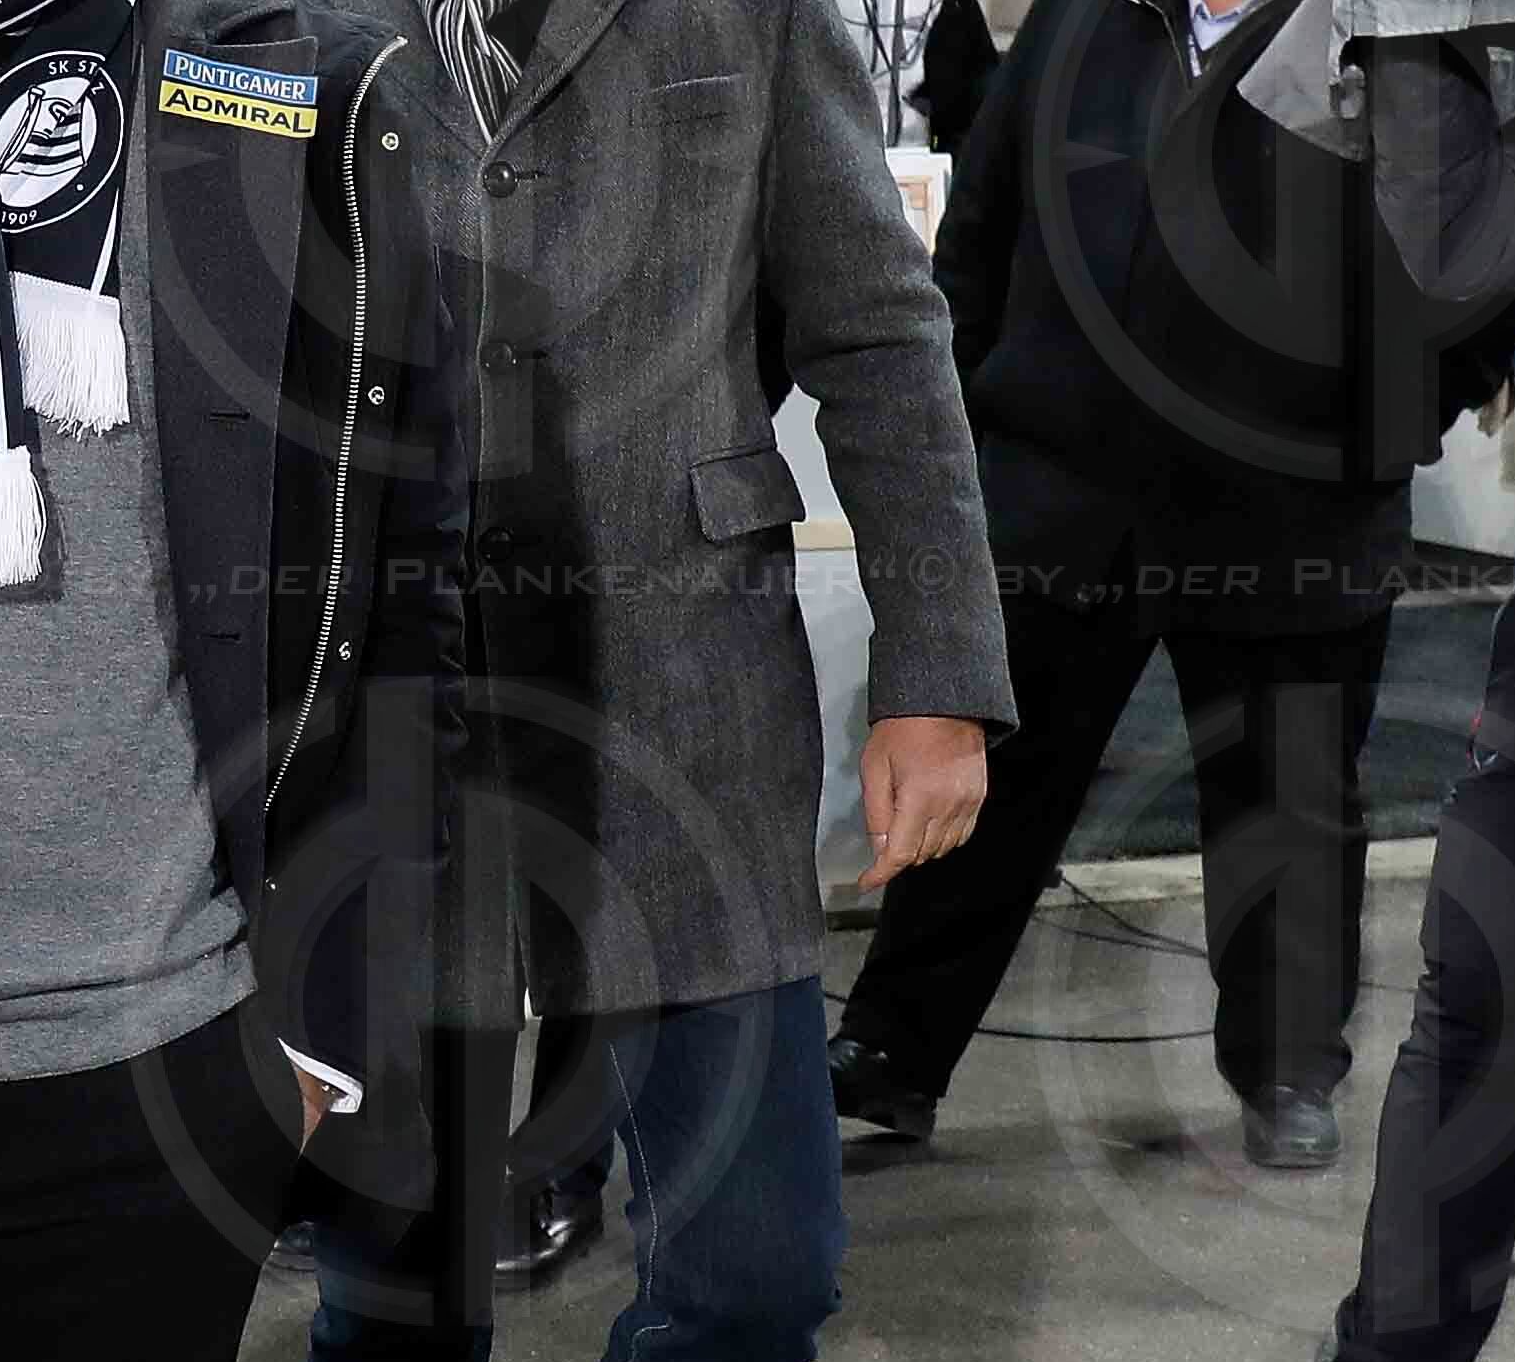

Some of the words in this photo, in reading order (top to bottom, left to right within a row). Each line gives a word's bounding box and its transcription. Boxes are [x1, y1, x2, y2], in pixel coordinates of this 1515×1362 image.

[48, 59, 69, 76] SK
[174, 54, 308, 101] PUNTIGAMER
[164, 88, 312, 134] ADMIRAL
[1, 209, 38, 226] 1909
